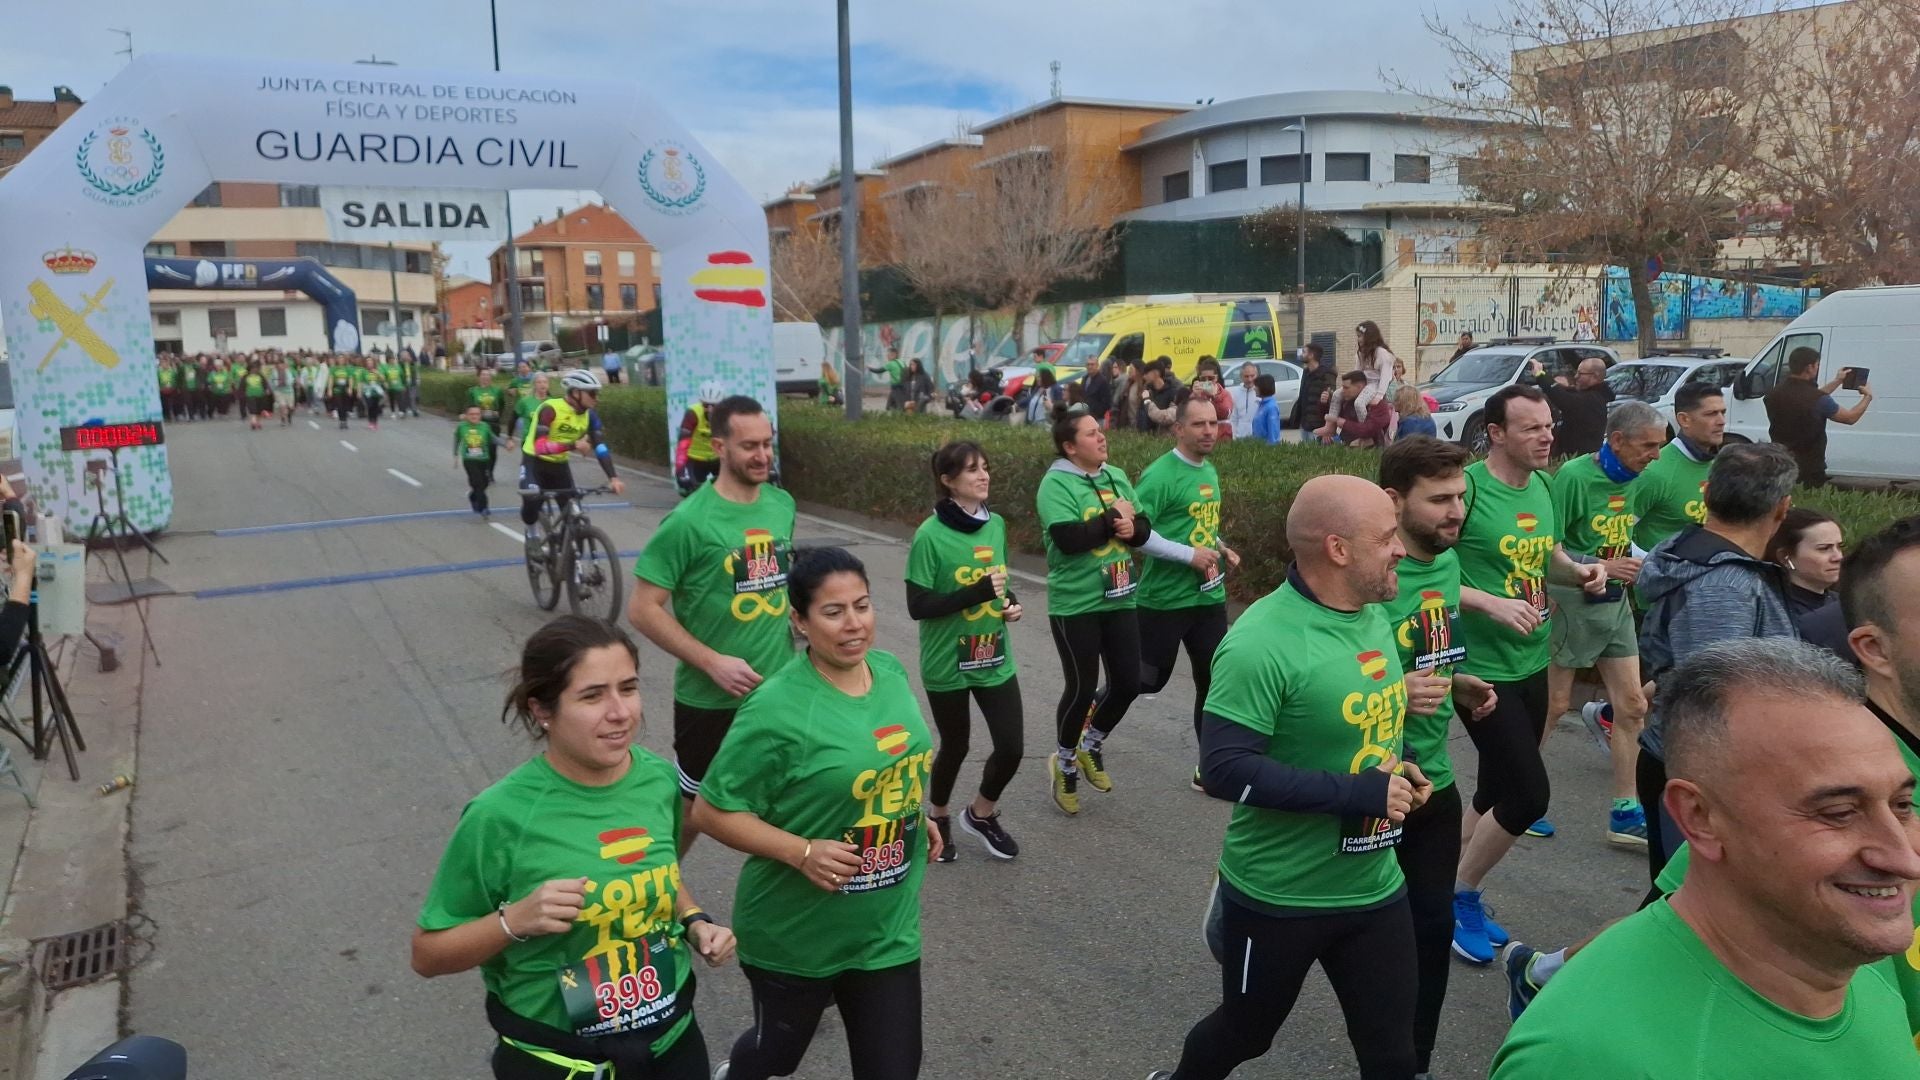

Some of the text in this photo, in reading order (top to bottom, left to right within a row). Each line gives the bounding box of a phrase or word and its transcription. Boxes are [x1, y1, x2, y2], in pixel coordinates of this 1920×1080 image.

[257, 76, 577, 104] JUNTA CENTRAL DE EDUCACIÓN
[325, 99, 518, 124] FÍSICA Y DEPORTES
[255, 129, 579, 169] GUARDIA CIVIL
[342, 200, 491, 229] SALIDA
[1157, 317, 1205, 327] AMBULANCIA
[1173, 336, 1201, 346] La Rioja
[1173, 345, 1195, 355] Cuida
[1592, 513, 1634, 533] Corre
[1499, 534, 1554, 556] Corre
[747, 555, 779, 580] 254
[1510, 550, 1545, 574] TEA
[1431, 625, 1449, 652] 11
[975, 644, 995, 660] 60
[1342, 679, 1406, 724] Corr
[1346, 844, 1378, 853] GUARDIA
[1378, 839, 1395, 848] CIVIL
[1347, 835, 1380, 845] CARRERA
[861, 839, 905, 874] 393
[843, 877, 896, 891] GUARDIA CIVIL
[849, 872, 880, 883] ARRERA
[595, 965, 662, 1019] 398
[582, 1013, 631, 1033] CARRERA
[631, 1014, 659, 1030] CIVIL
